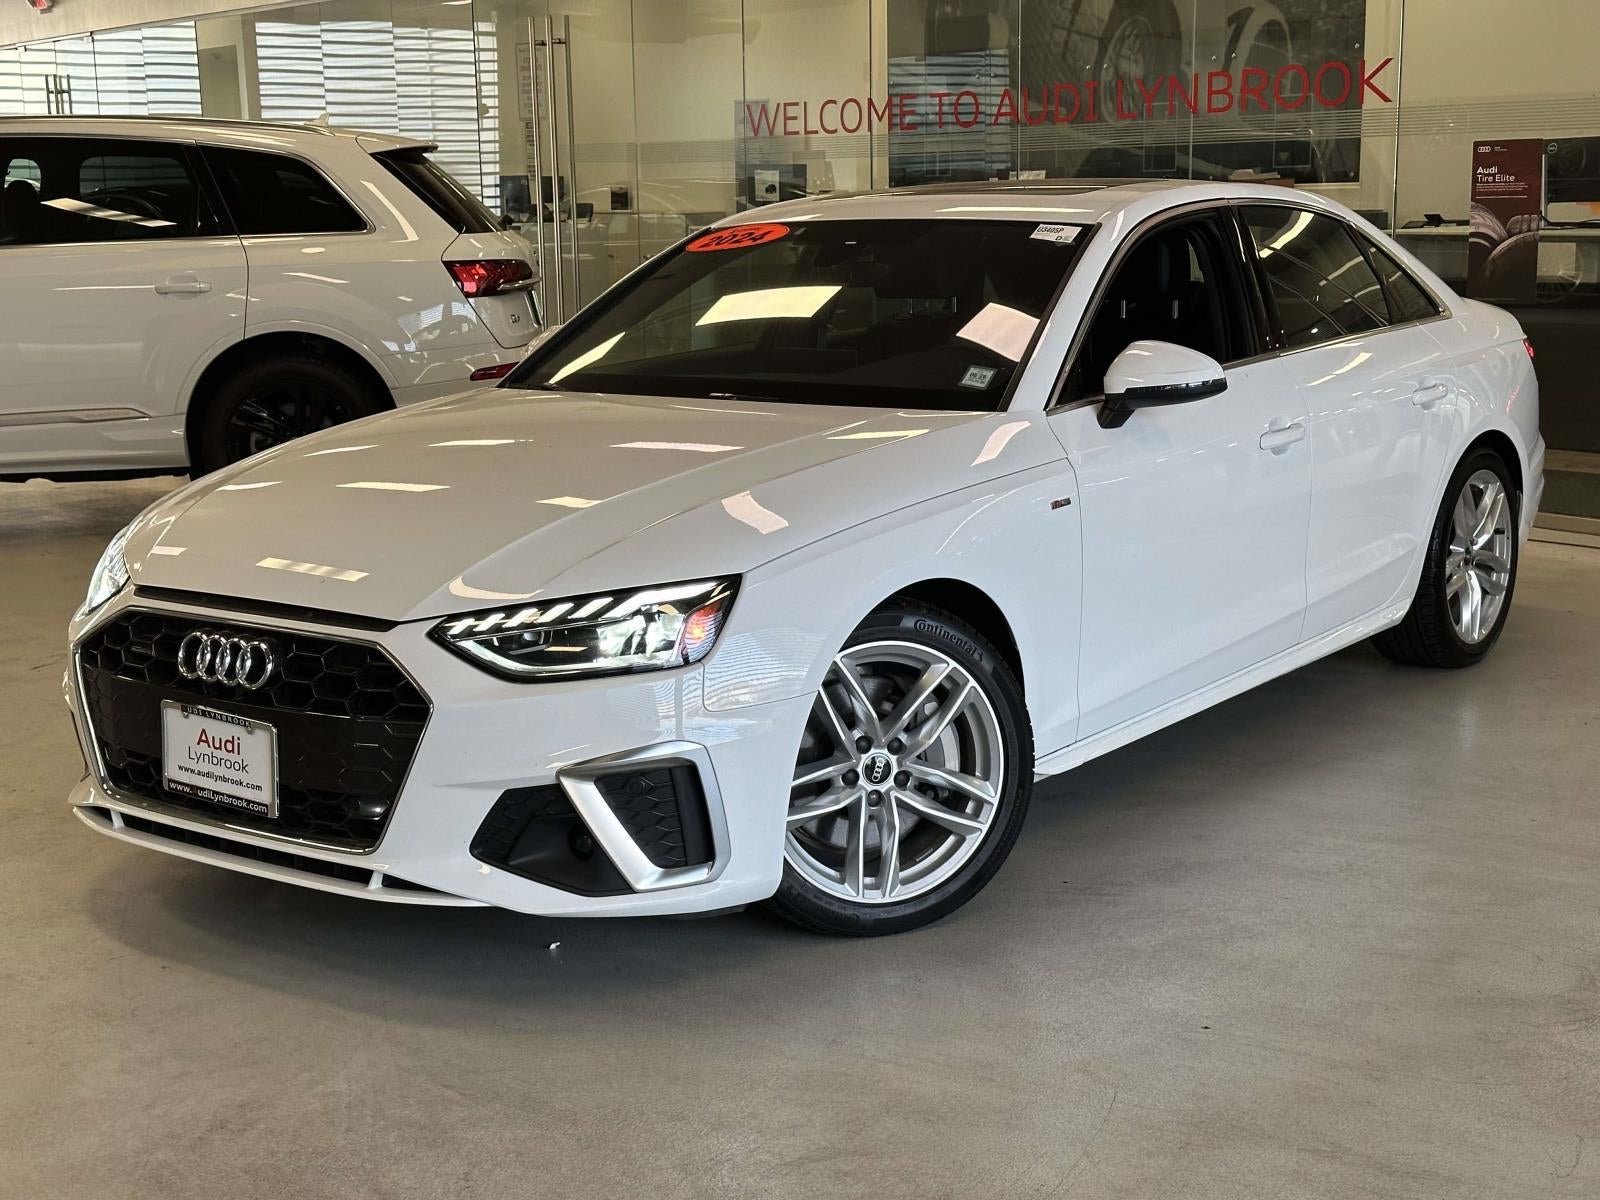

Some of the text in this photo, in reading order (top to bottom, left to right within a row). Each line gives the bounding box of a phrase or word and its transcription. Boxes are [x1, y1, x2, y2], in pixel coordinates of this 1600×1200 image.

[746, 57, 1394, 136] WELCOME TO AUDI LYNBROOK
[1476, 165, 1498, 174] Audi
[1476, 174, 1516, 183] Tire Elite
[697, 230, 774, 249] 2024
[913, 618, 978, 657] Continental
[205, 711, 251, 727] LYNBROOK
[197, 728, 241, 755] Audi
[188, 746, 249, 774] Lynbrook
[178, 763, 263, 792] www.audilynbrook.com
